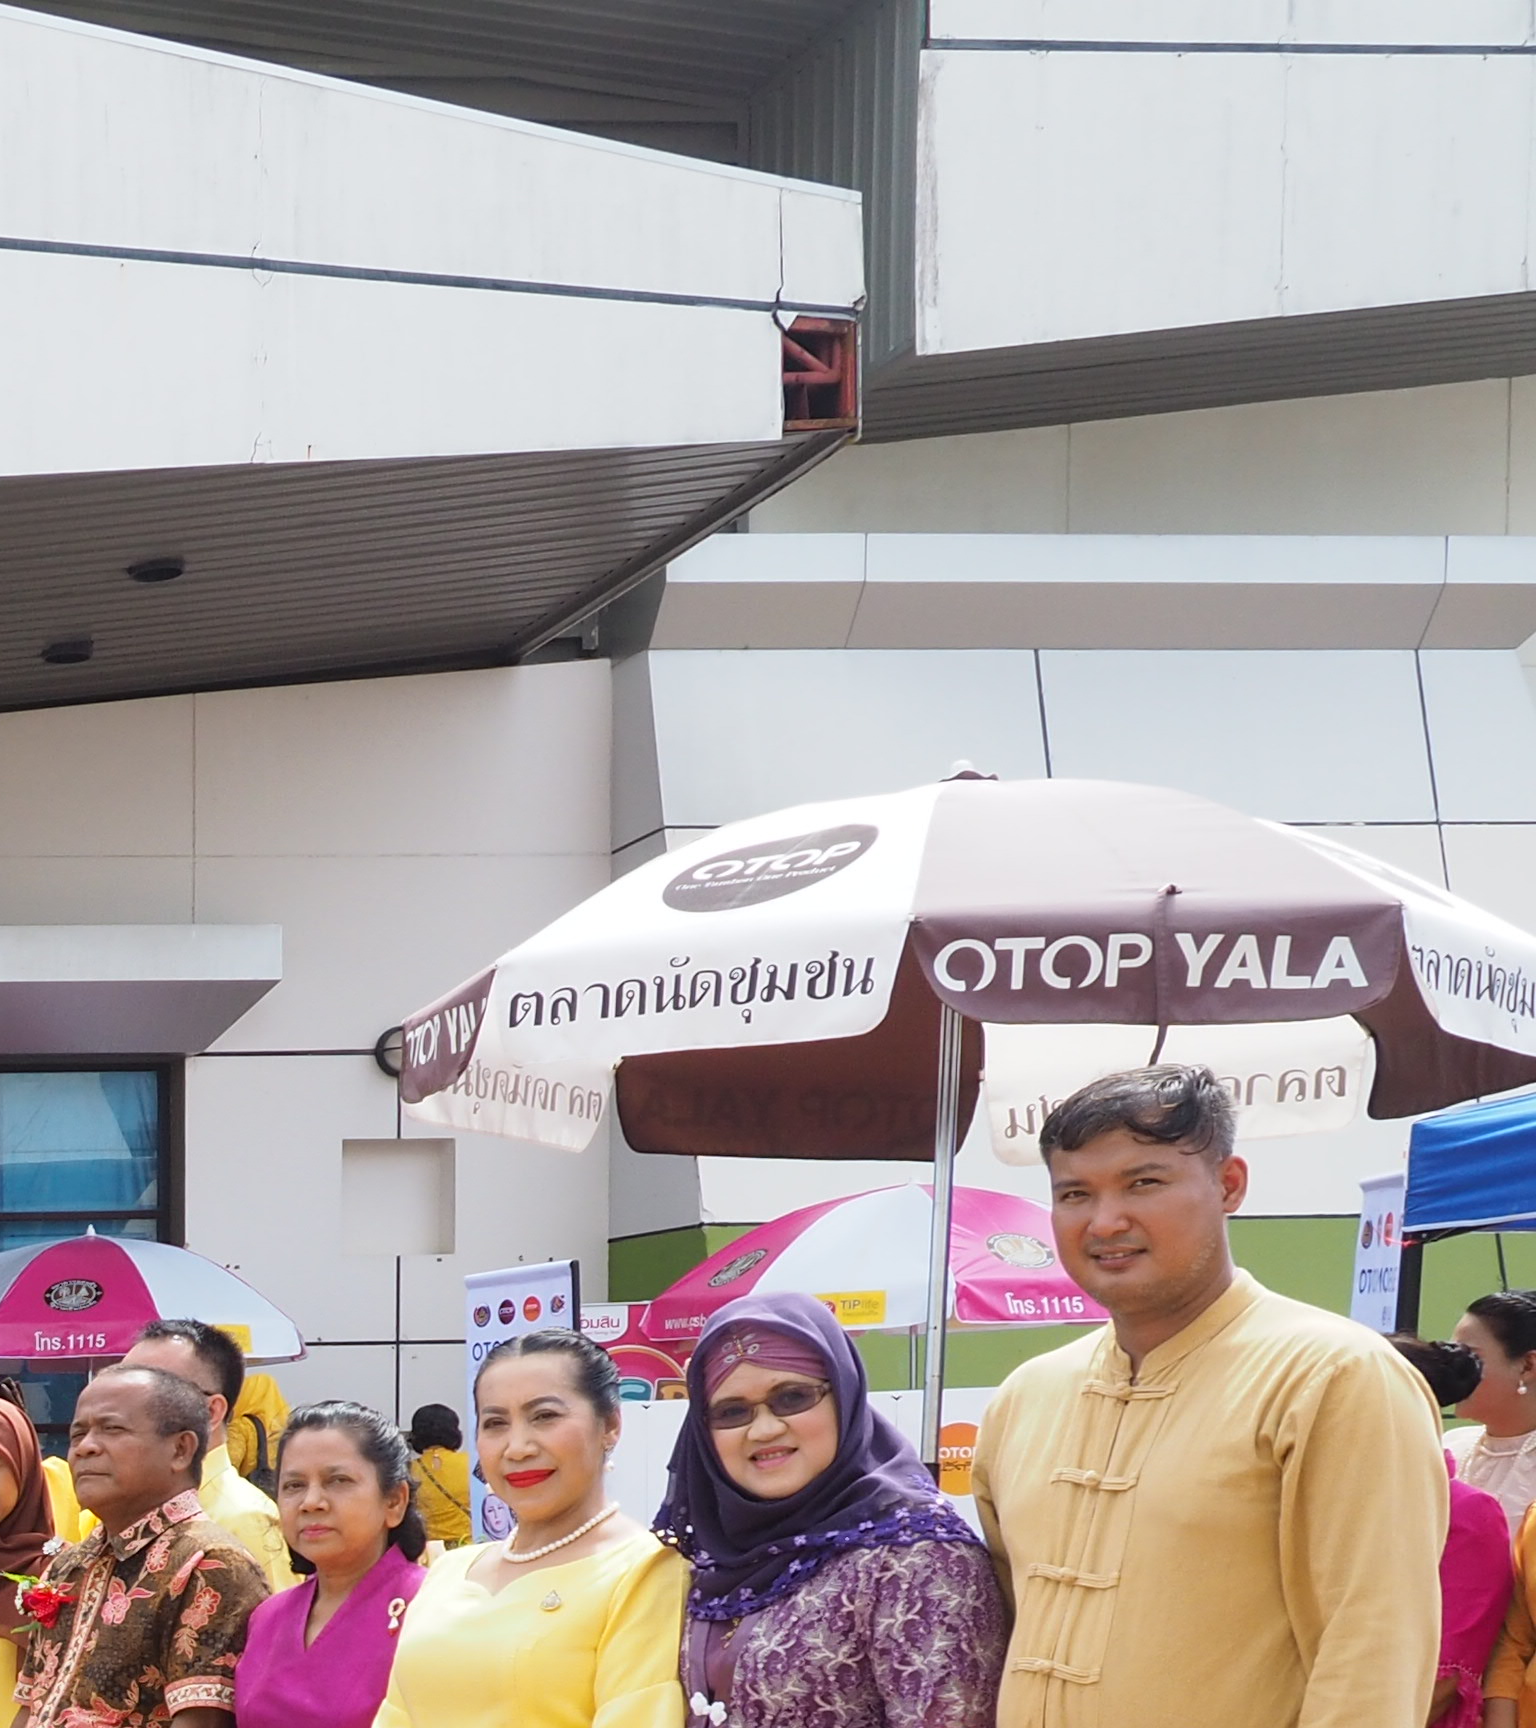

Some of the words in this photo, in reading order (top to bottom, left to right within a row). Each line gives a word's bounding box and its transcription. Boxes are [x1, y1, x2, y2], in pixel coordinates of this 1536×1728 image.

[691, 840, 862, 881] OTOP
[932, 932, 1154, 992] OTOP
[1174, 932, 1369, 990] YALA
[508, 950, 876, 1029] ตลาดนัดชุมชน
[1004, 1291, 1085, 1315] โทร.1115
[33, 1330, 107, 1352] โทร.1115
